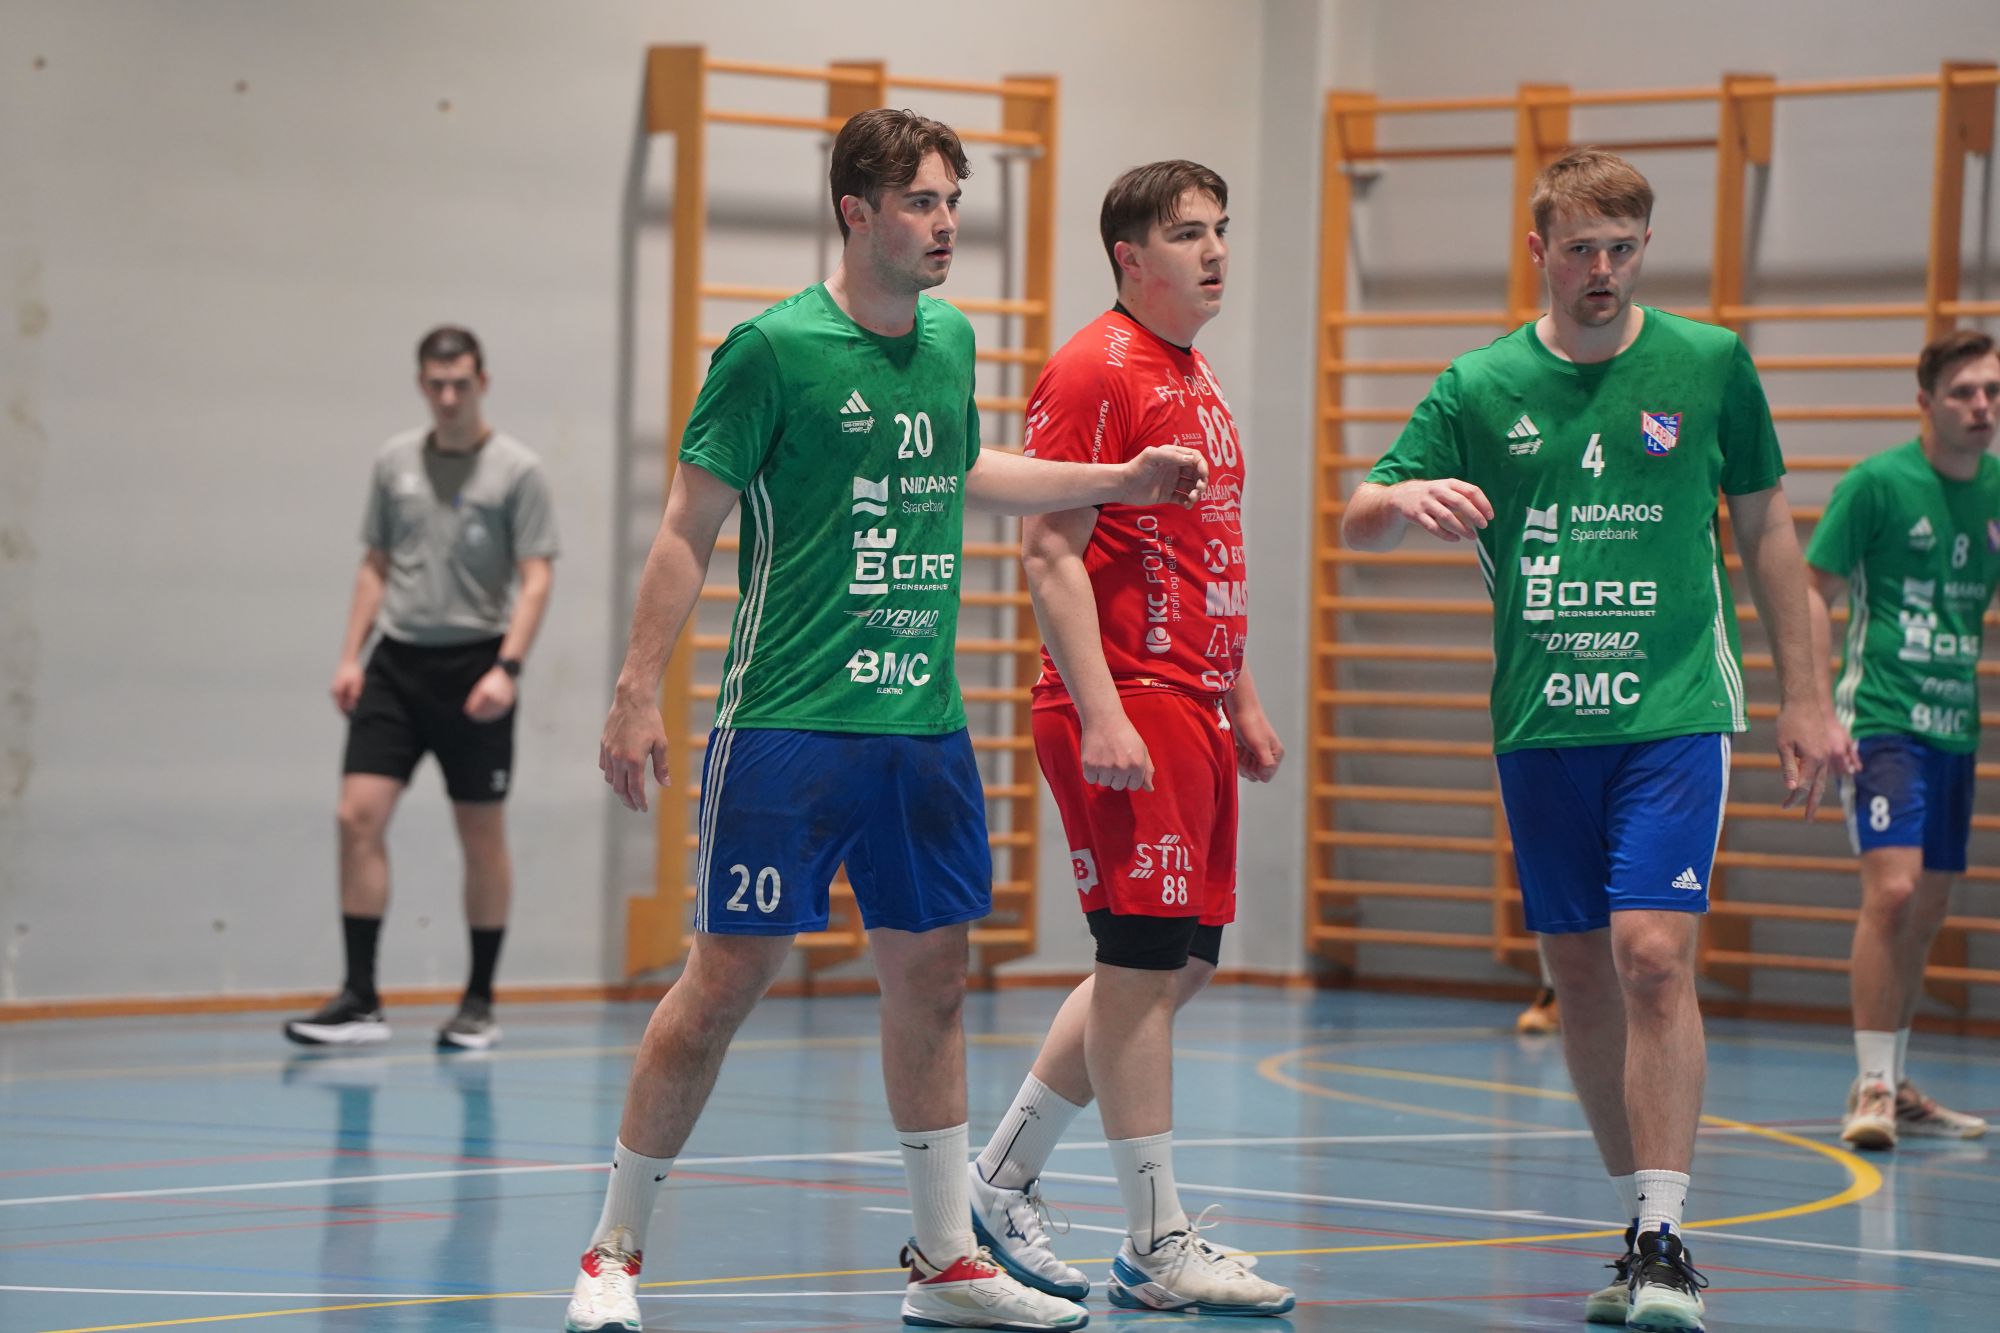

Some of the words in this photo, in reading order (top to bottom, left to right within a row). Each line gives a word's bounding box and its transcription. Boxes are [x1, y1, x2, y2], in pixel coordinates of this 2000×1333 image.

[894, 412, 934, 460] 20
[1197, 404, 1238, 468] 88
[1581, 433, 1605, 478] 4
[900, 475, 958, 494] NIDAROS
[1570, 504, 1664, 523] NIDAROS
[1136, 515, 1166, 584] FOLLO
[1570, 528, 1639, 542] Sparebank
[855, 551, 955, 580] BORG
[1952, 533, 1970, 568] 8
[1147, 593, 1168, 623] KC
[1526, 578, 1657, 608] BORG
[866, 608, 939, 628] DYBVAD
[1557, 609, 1657, 618] REGNSKAPSHUSET
[1546, 631, 1640, 651] DYBVAD
[845, 648, 931, 687] BMC
[1543, 671, 1641, 707] BMC
[1575, 708, 1610, 716] ELEKTRO
[1869, 795, 1891, 832] 8
[1135, 842, 1195, 873] STIL
[726, 863, 781, 914] 20
[1161, 874, 1188, 905] 88
[1671, 880, 1702, 890] adidas
